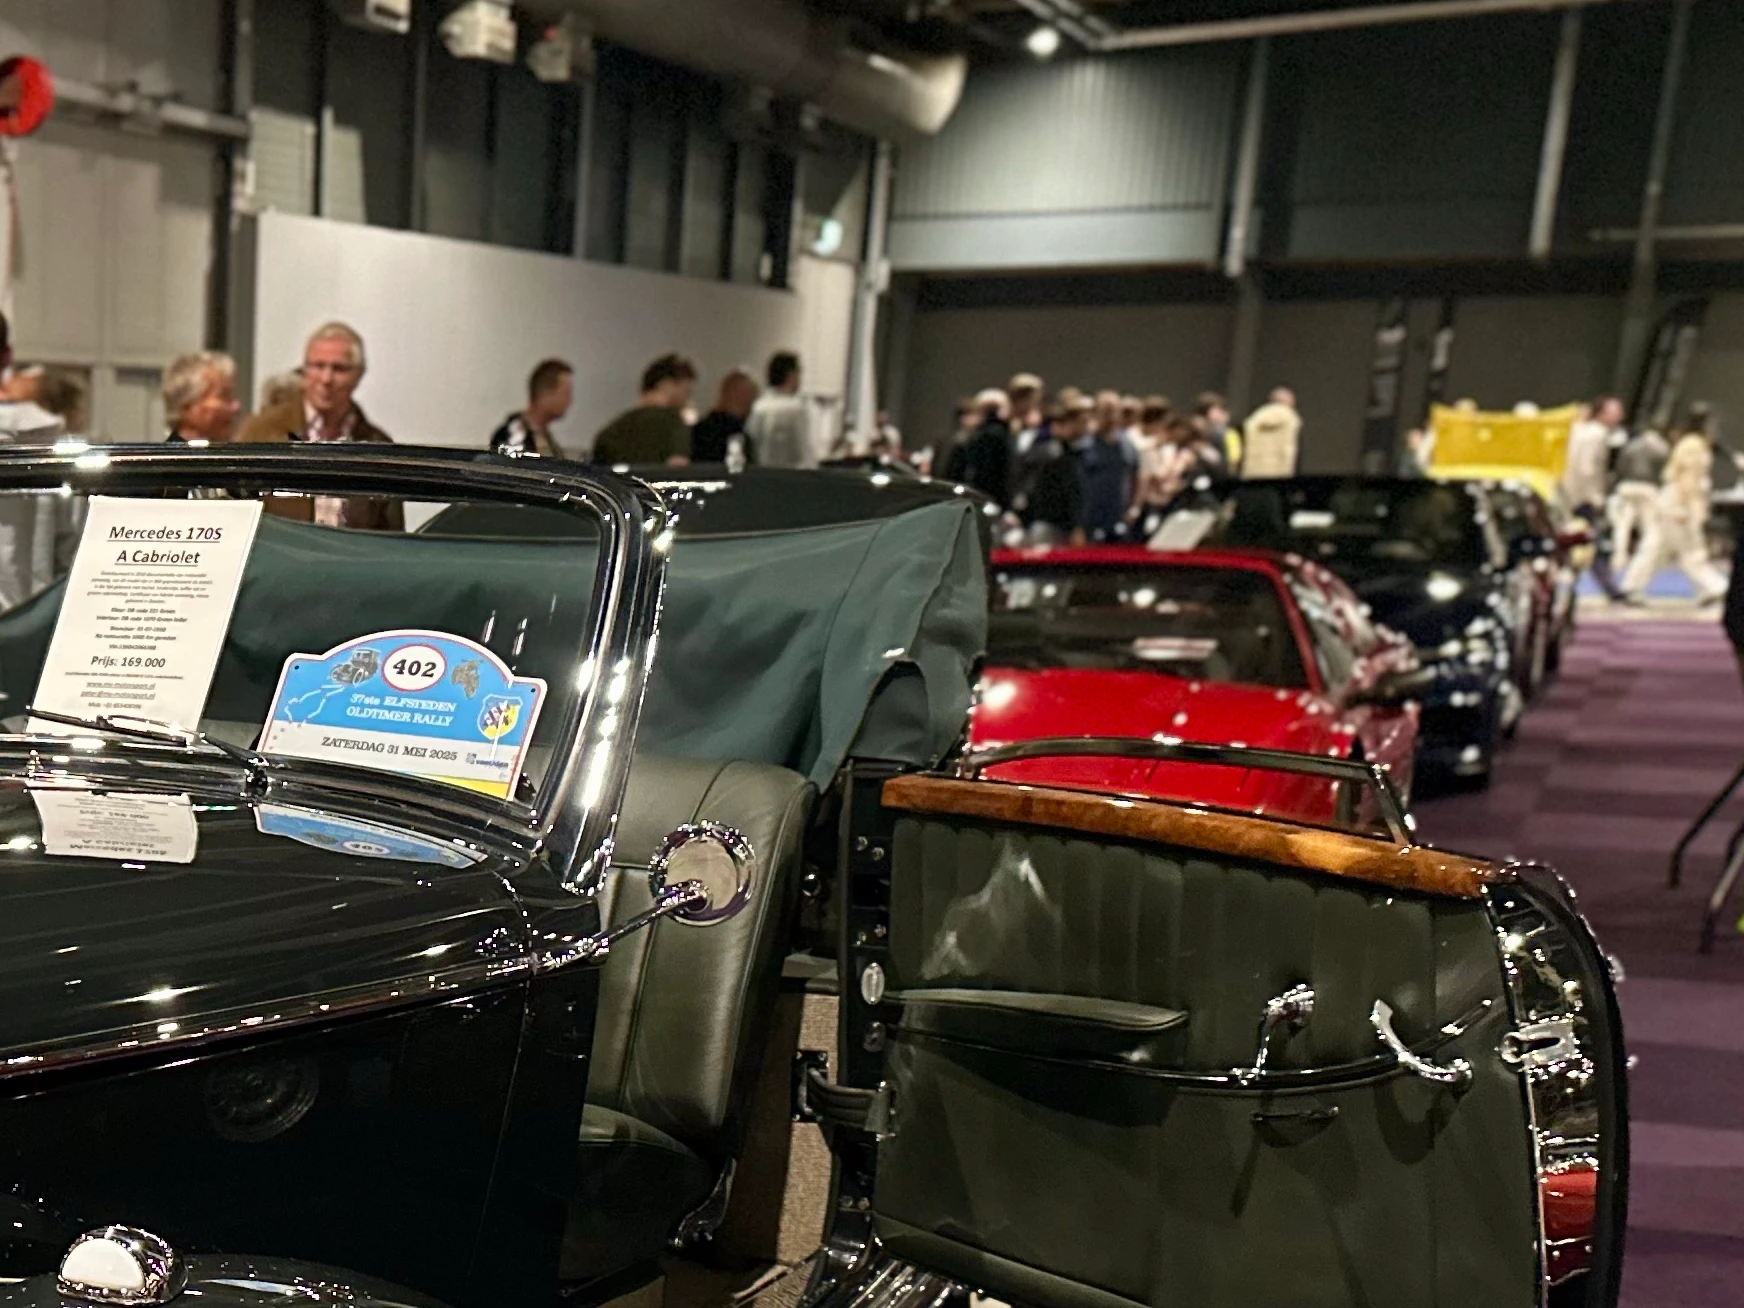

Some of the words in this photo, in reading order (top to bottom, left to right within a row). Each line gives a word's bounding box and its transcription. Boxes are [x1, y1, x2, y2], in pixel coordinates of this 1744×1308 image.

[109, 526, 182, 539] Mercedes
[185, 527, 223, 540] 170S
[116, 550, 127, 563] A
[132, 550, 201, 564] Cabriolet
[90, 656, 118, 668] Prijs:
[120, 656, 166, 668] 169.000
[393, 658, 437, 678] 402
[383, 696, 457, 713] ELFSTEDEN
[346, 706, 411, 723] OLDTIMER
[412, 713, 454, 727] RALLY
[321, 736, 386, 755] ZATERDAG
[387, 744, 399, 756] 31
[402, 746, 428, 757] MEI
[429, 748, 458, 761] 2025
